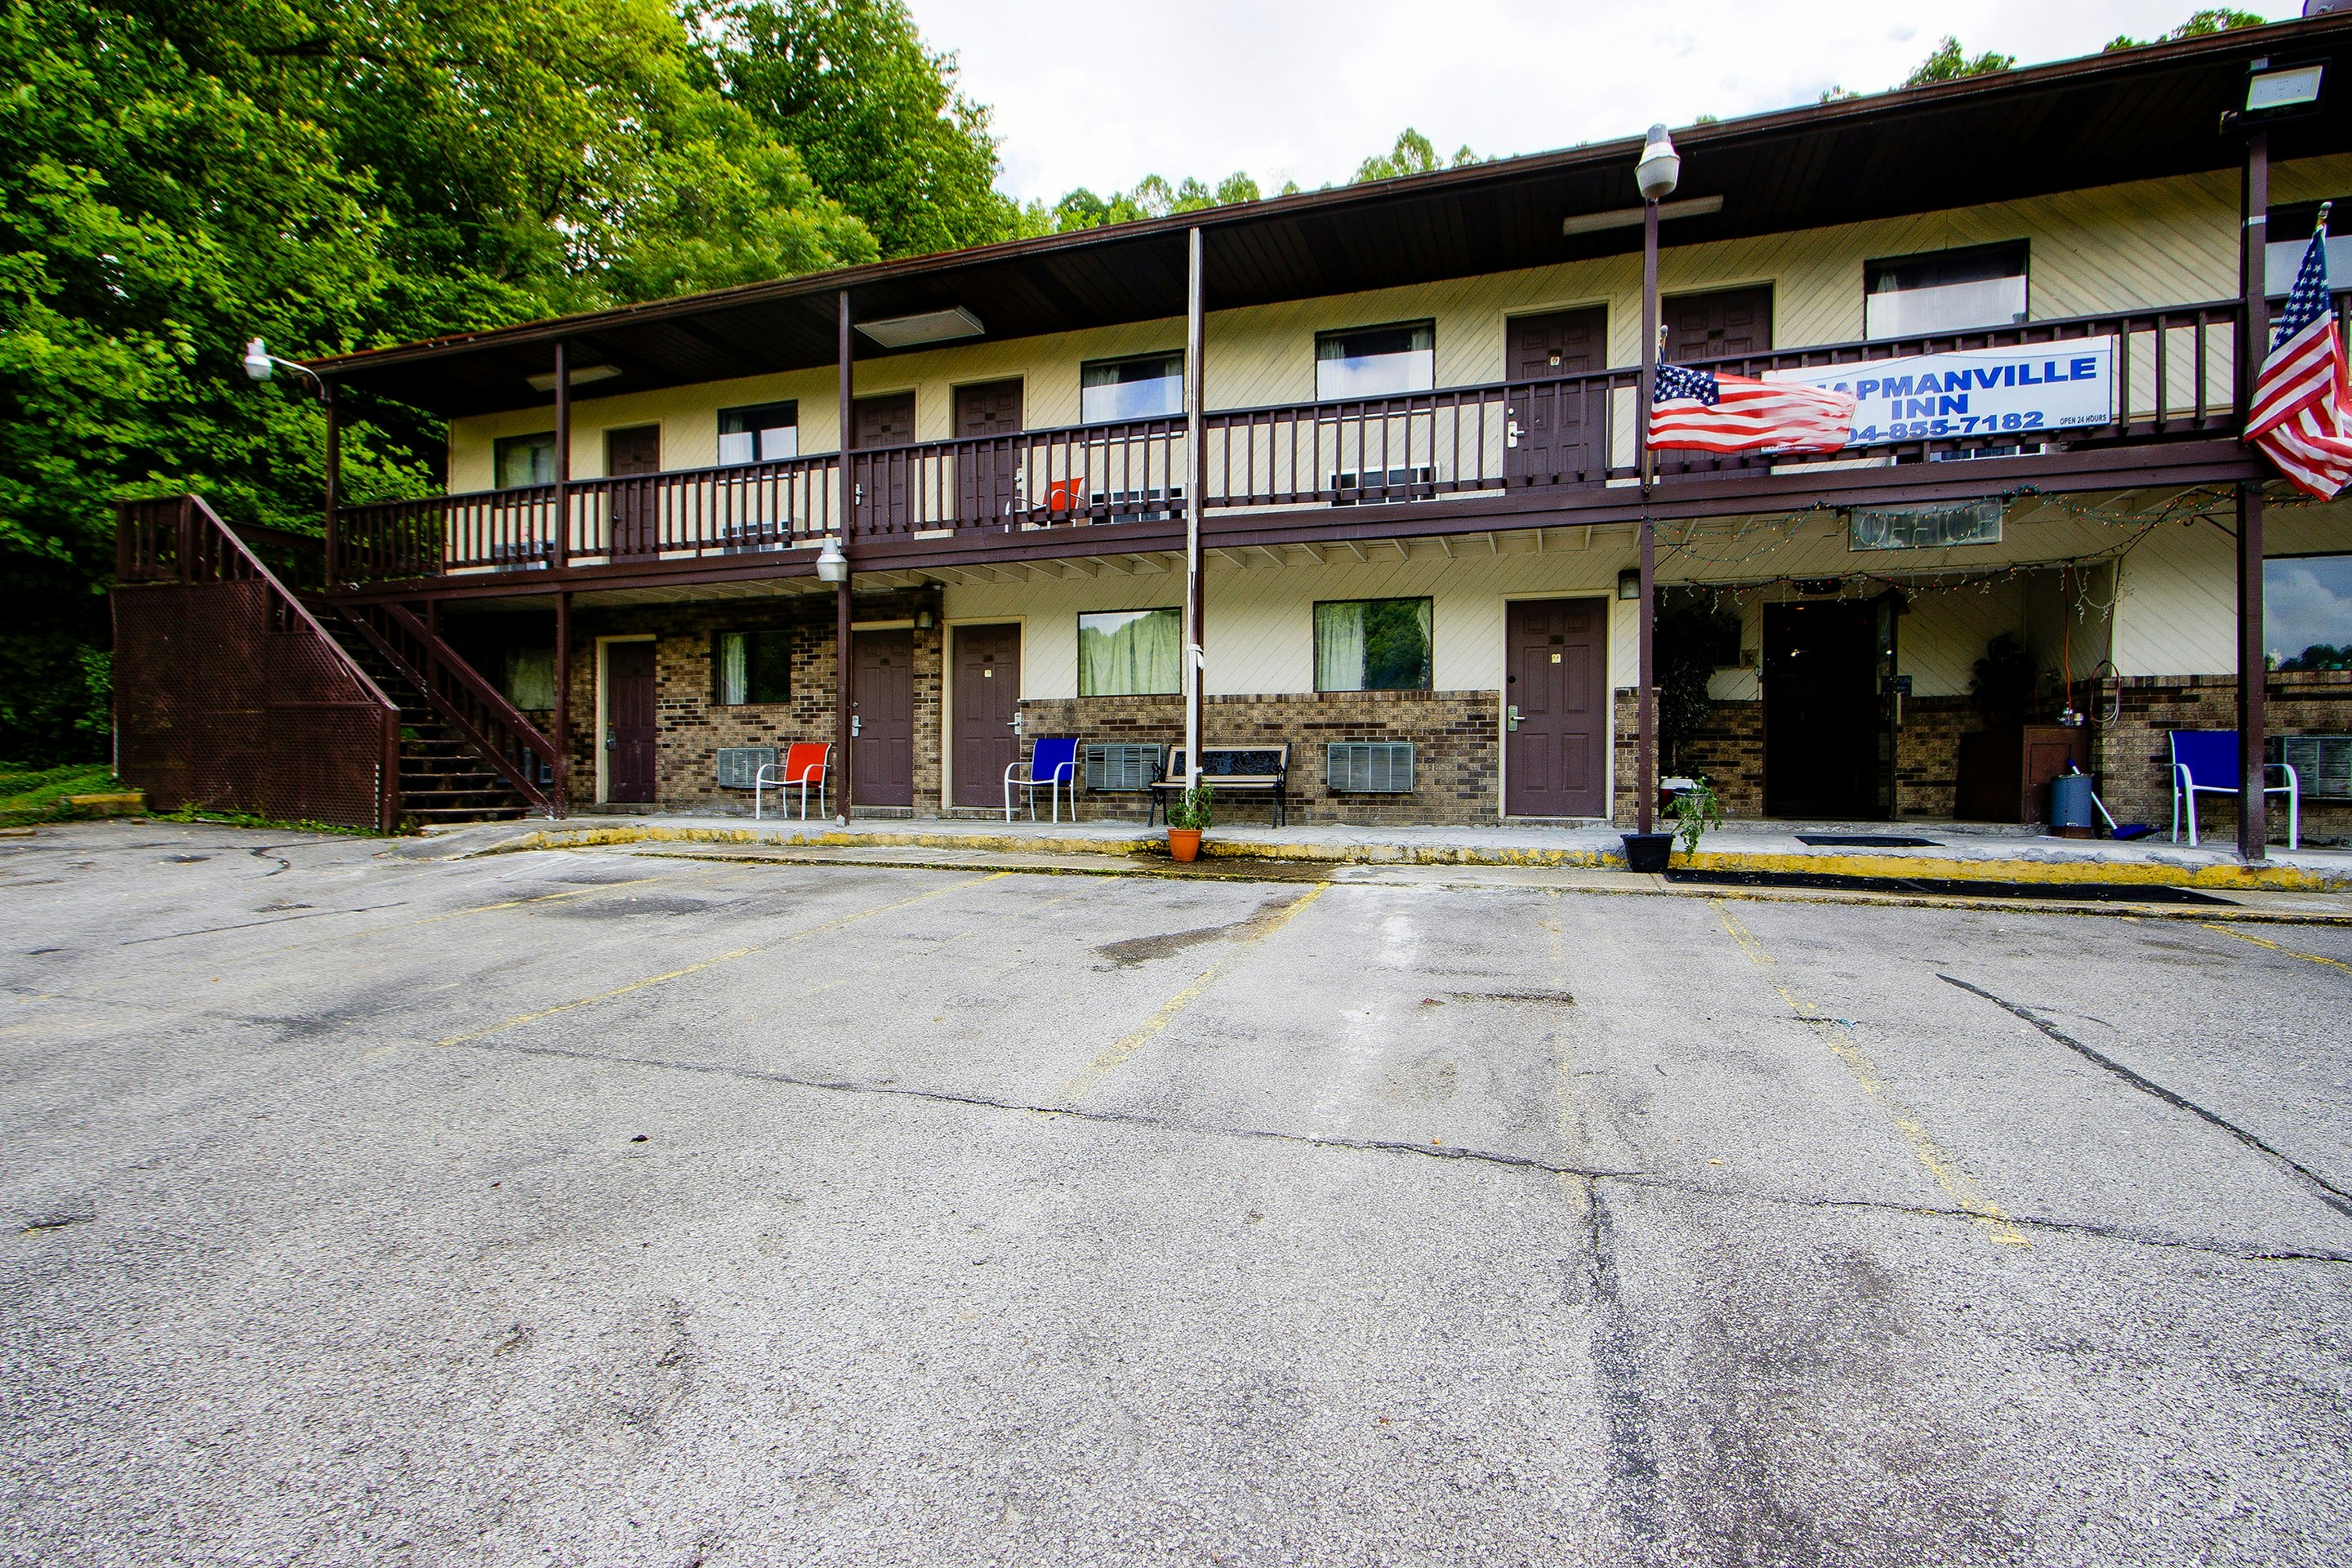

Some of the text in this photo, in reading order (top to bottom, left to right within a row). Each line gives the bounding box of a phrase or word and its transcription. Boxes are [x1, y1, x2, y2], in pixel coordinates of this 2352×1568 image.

[1817, 358, 2096, 400] APMANVILLE
[1891, 394, 1968, 420] INN
[2060, 414, 2107, 425] OPEN 24 HOURS
[1848, 412, 2043, 443] 04-855-7182
[1860, 504, 1998, 546] OFFICE
